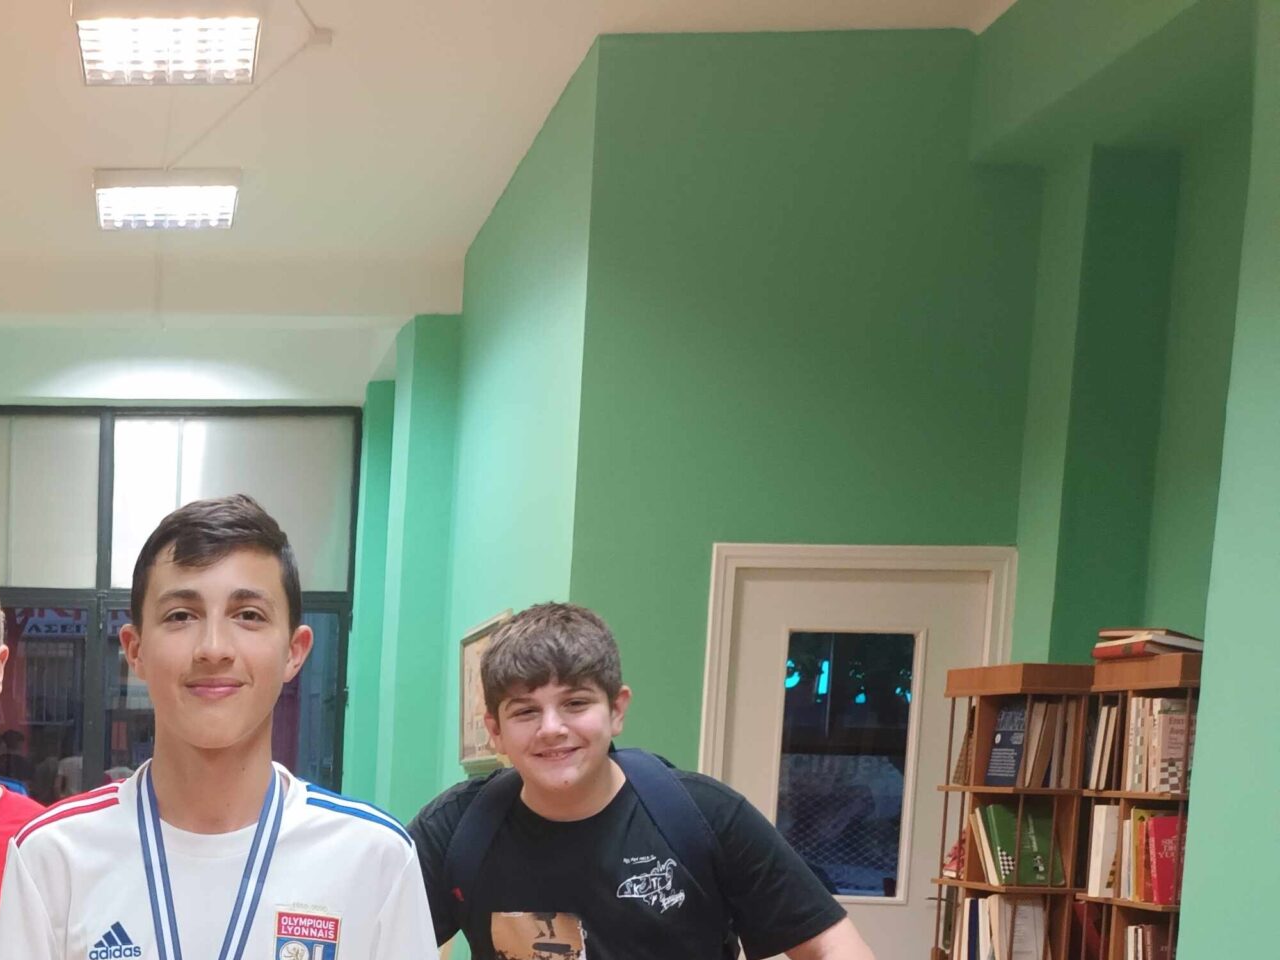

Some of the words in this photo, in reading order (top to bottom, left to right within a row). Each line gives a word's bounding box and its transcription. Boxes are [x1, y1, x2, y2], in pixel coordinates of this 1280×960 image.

[281, 916, 336, 930] OLYMPIQUE
[281, 925, 335, 939] LYONNAIS
[89, 944, 142, 960] adidas
